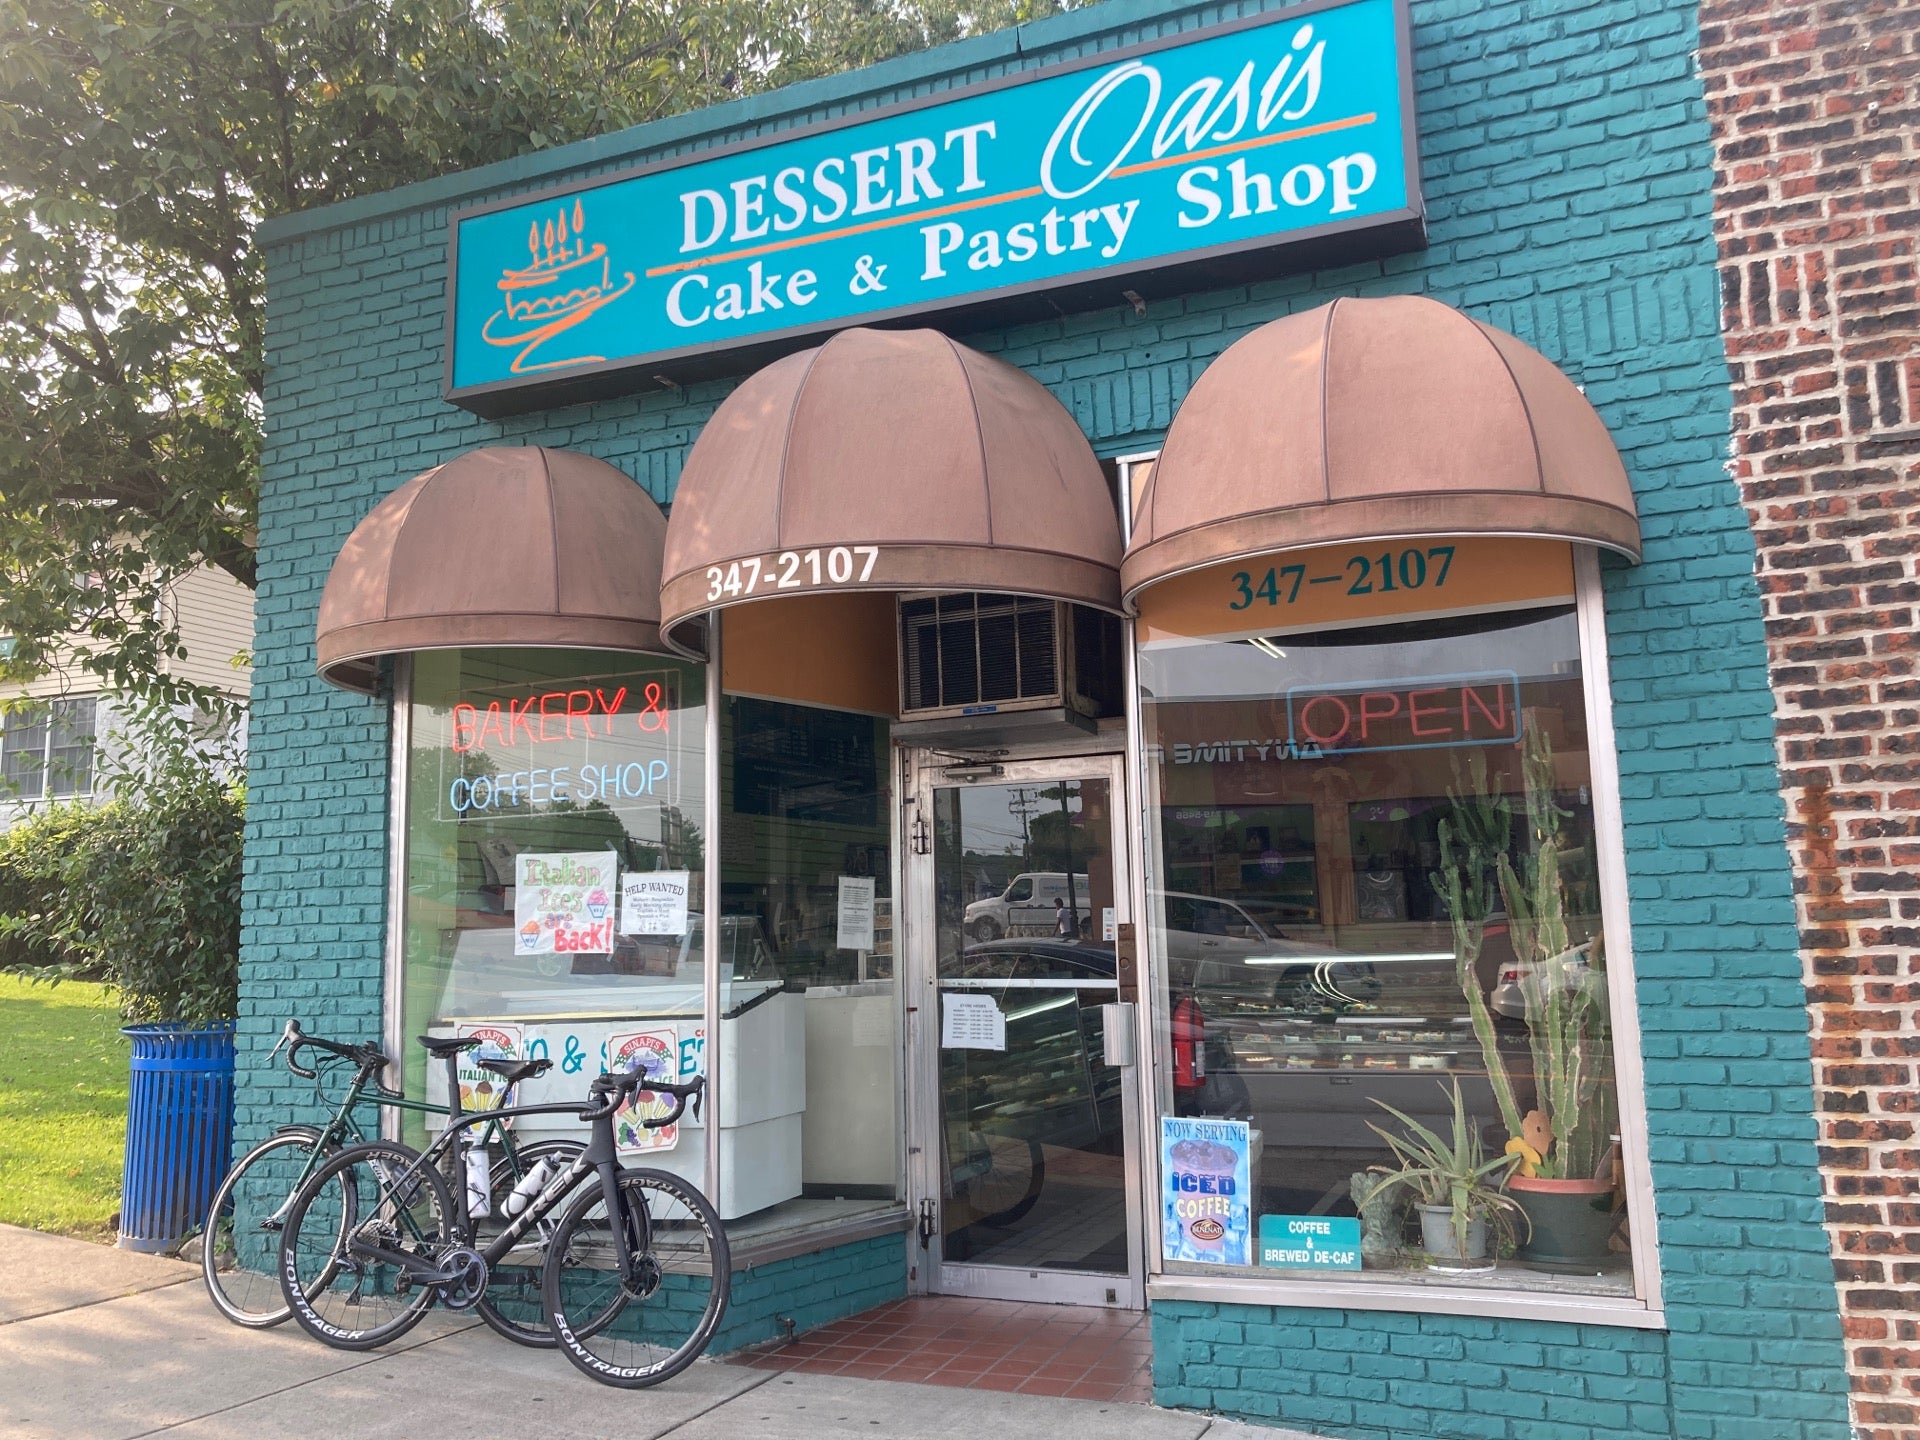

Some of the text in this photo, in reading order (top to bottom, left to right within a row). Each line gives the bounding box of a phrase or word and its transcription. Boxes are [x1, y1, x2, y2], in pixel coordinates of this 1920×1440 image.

[679, 24, 1327, 253] DESSERT Oasis
[665, 151, 1377, 328] Cake & Pastry Shop
[706, 546, 879, 602] 347-2107
[1229, 545, 1456, 611] 347-2107
[452, 682, 669, 752] BAKERY &
[1300, 684, 1506, 743] OPEN
[450, 760, 669, 811] COFFEE SHOP
[524, 857, 601, 887] Italian
[625, 882, 685, 897] HELP WANTED
[537, 887, 583, 913] Ices
[459, 1069, 495, 1082] ITALIAN
[562, 1035, 586, 1074] &
[1165, 1122, 1246, 1142] NOW SERVING
[503, 1155, 588, 1238] TREK
[1171, 1172, 1236, 1196] ICED
[617, 1178, 714, 1239] BONTRAGE
[1175, 1196, 1231, 1219] COFFEE
[1288, 1221, 1331, 1235] COFFEE
[1264, 1249, 1355, 1265] BREWED DE-CAF
[1306, 1237, 1314, 1249] &
[285, 1248, 364, 1340] BONTRAGER
[554, 1312, 666, 1378] BONTRAGER
